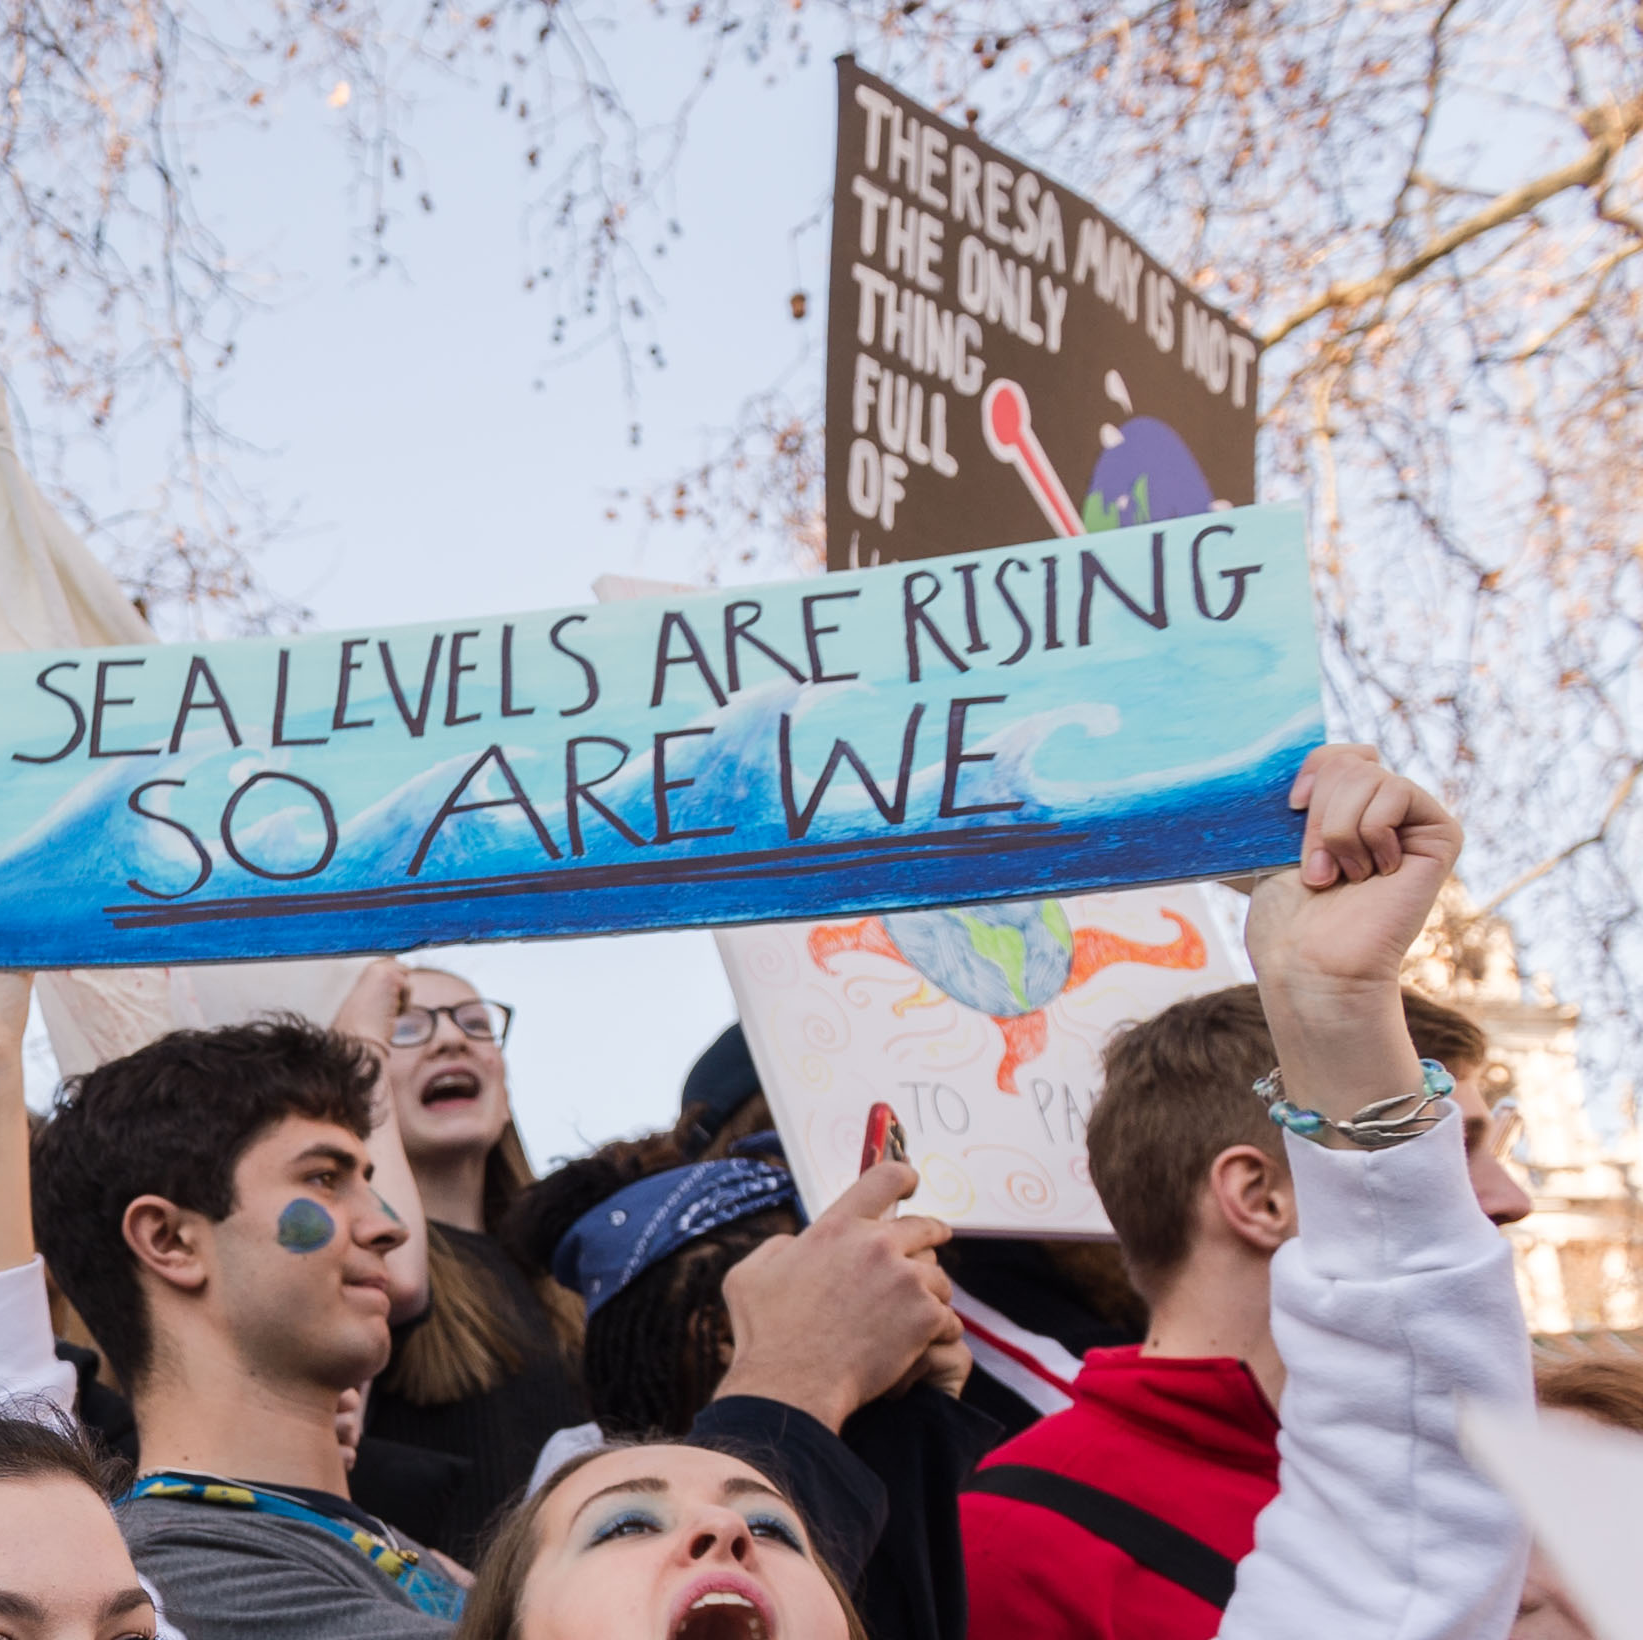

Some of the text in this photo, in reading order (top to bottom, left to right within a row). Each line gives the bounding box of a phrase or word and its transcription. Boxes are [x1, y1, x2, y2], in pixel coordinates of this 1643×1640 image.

[851, 176, 1068, 355] THE ONLY
[855, 84, 1256, 408] THERESA MAY IS NOT
[851, 261, 987, 397] THING
[846, 437, 909, 533] OF
[853, 352, 959, 479] FULL
[11, 523, 1265, 766] SEA LEVELS ARE RISING
[125, 692, 1028, 901] SO ARE WE
[898, 1080, 971, 1136] TO
